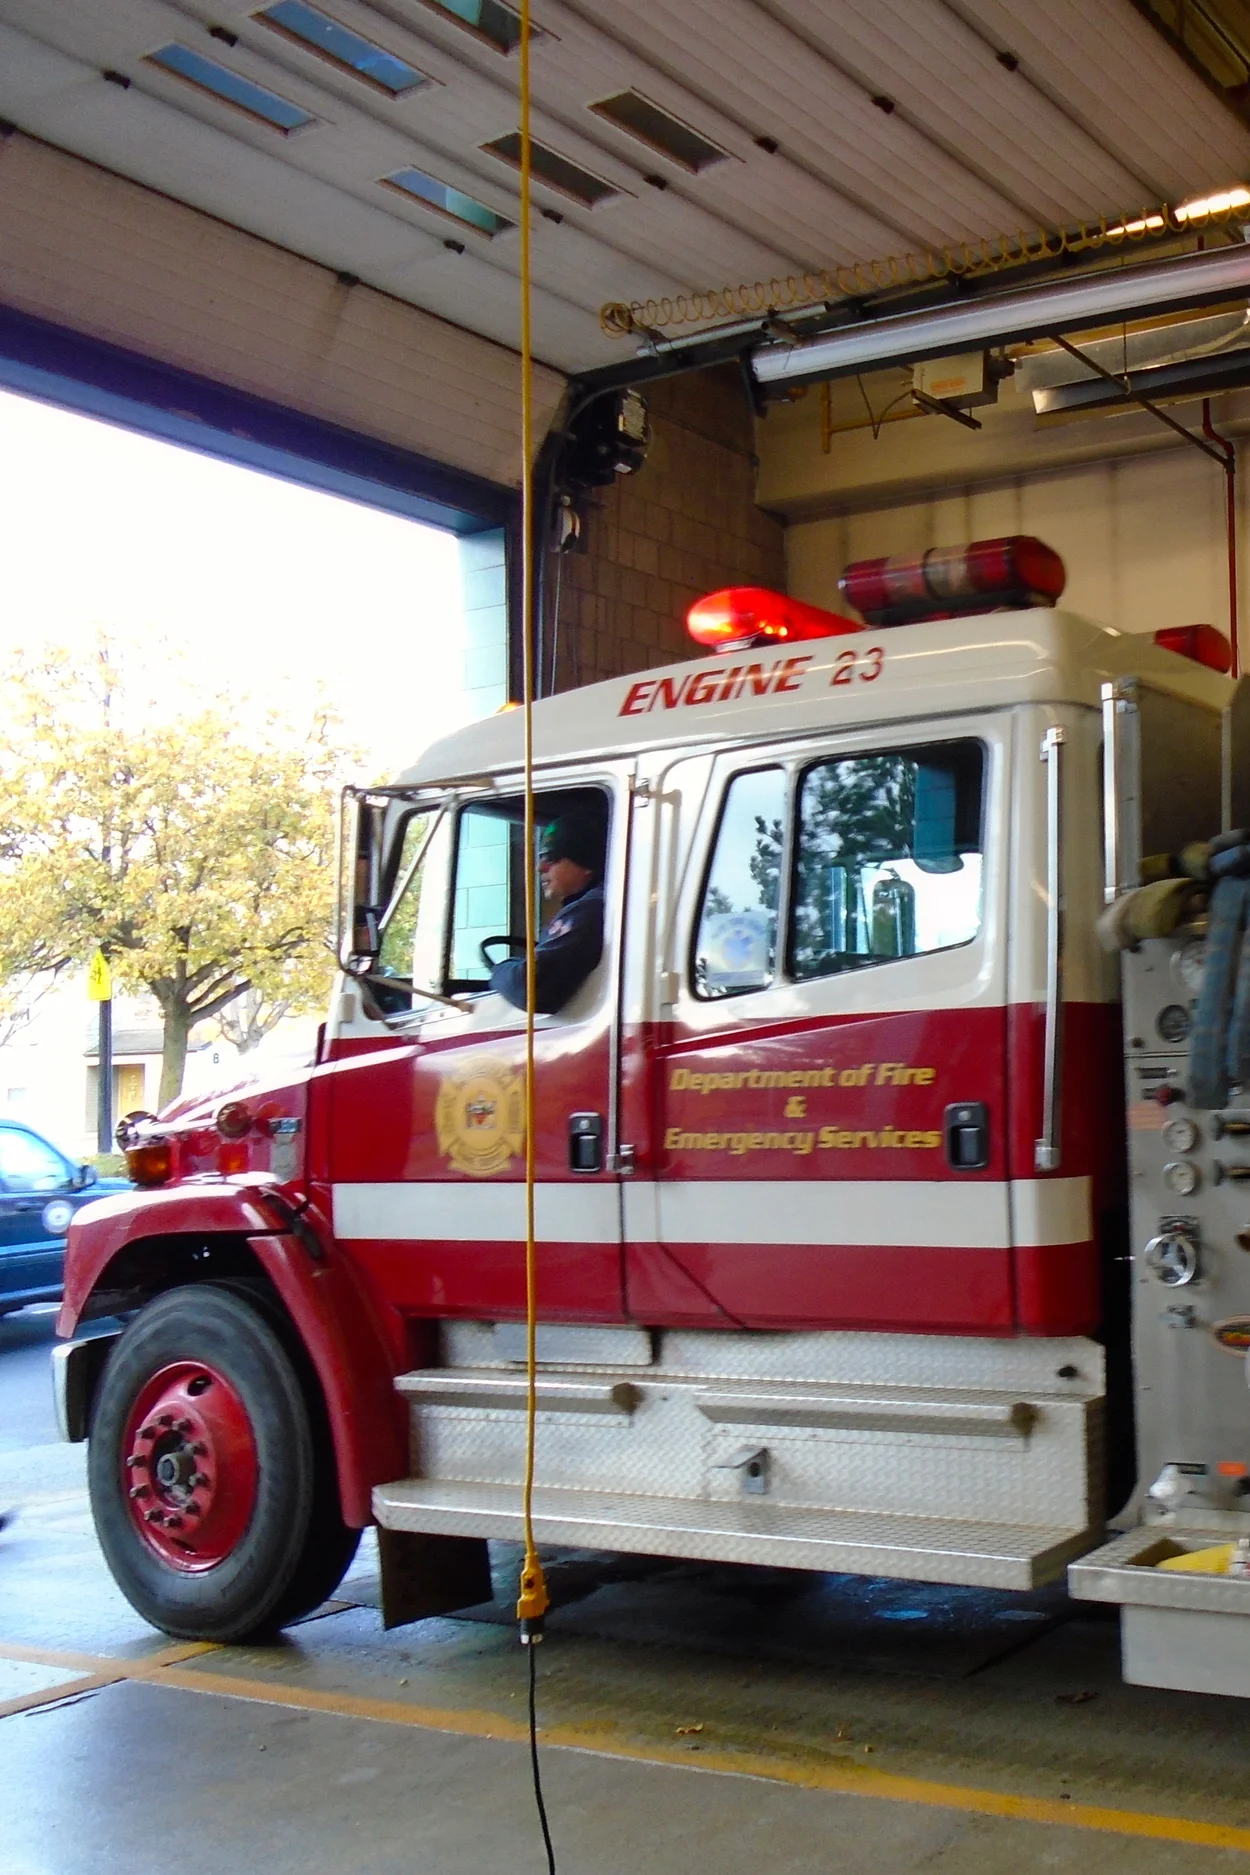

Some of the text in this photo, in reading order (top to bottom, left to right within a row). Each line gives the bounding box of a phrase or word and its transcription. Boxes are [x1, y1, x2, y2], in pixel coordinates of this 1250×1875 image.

[619, 646, 885, 717] ENGINE 23
[671, 1063, 936, 1094] Department of Fire
[784, 1096, 808, 1118] &
[664, 1126, 942, 1154] Emergency Services
